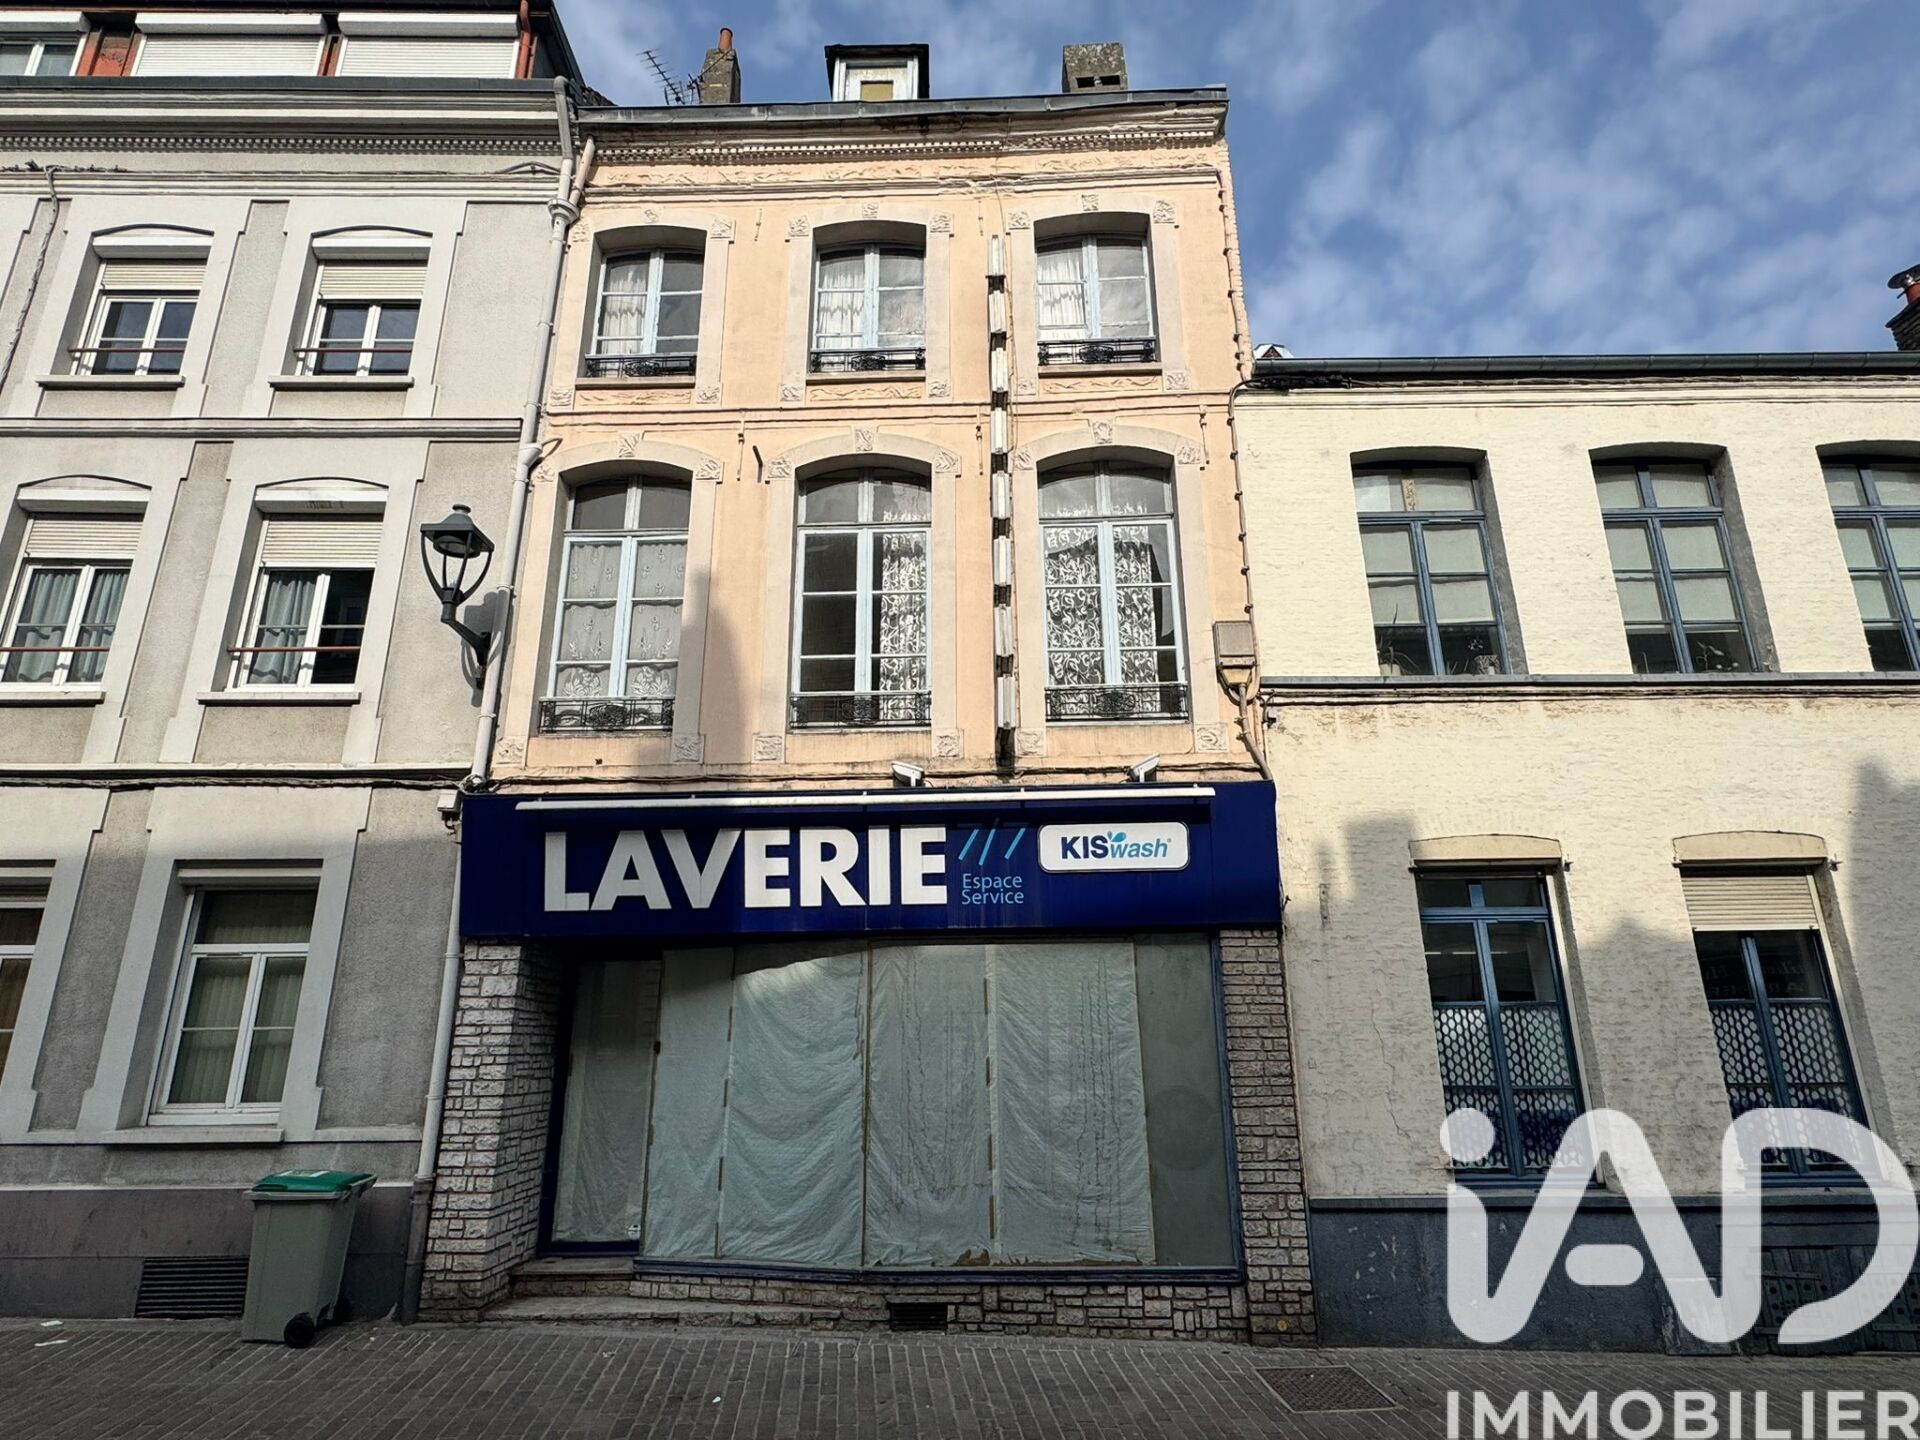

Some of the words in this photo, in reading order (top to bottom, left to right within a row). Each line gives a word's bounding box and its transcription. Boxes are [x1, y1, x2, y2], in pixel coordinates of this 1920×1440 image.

[544, 825, 948, 912] LAVERIE
[962, 872, 1023, 893] Espace
[961, 888, 1025, 905] Service
